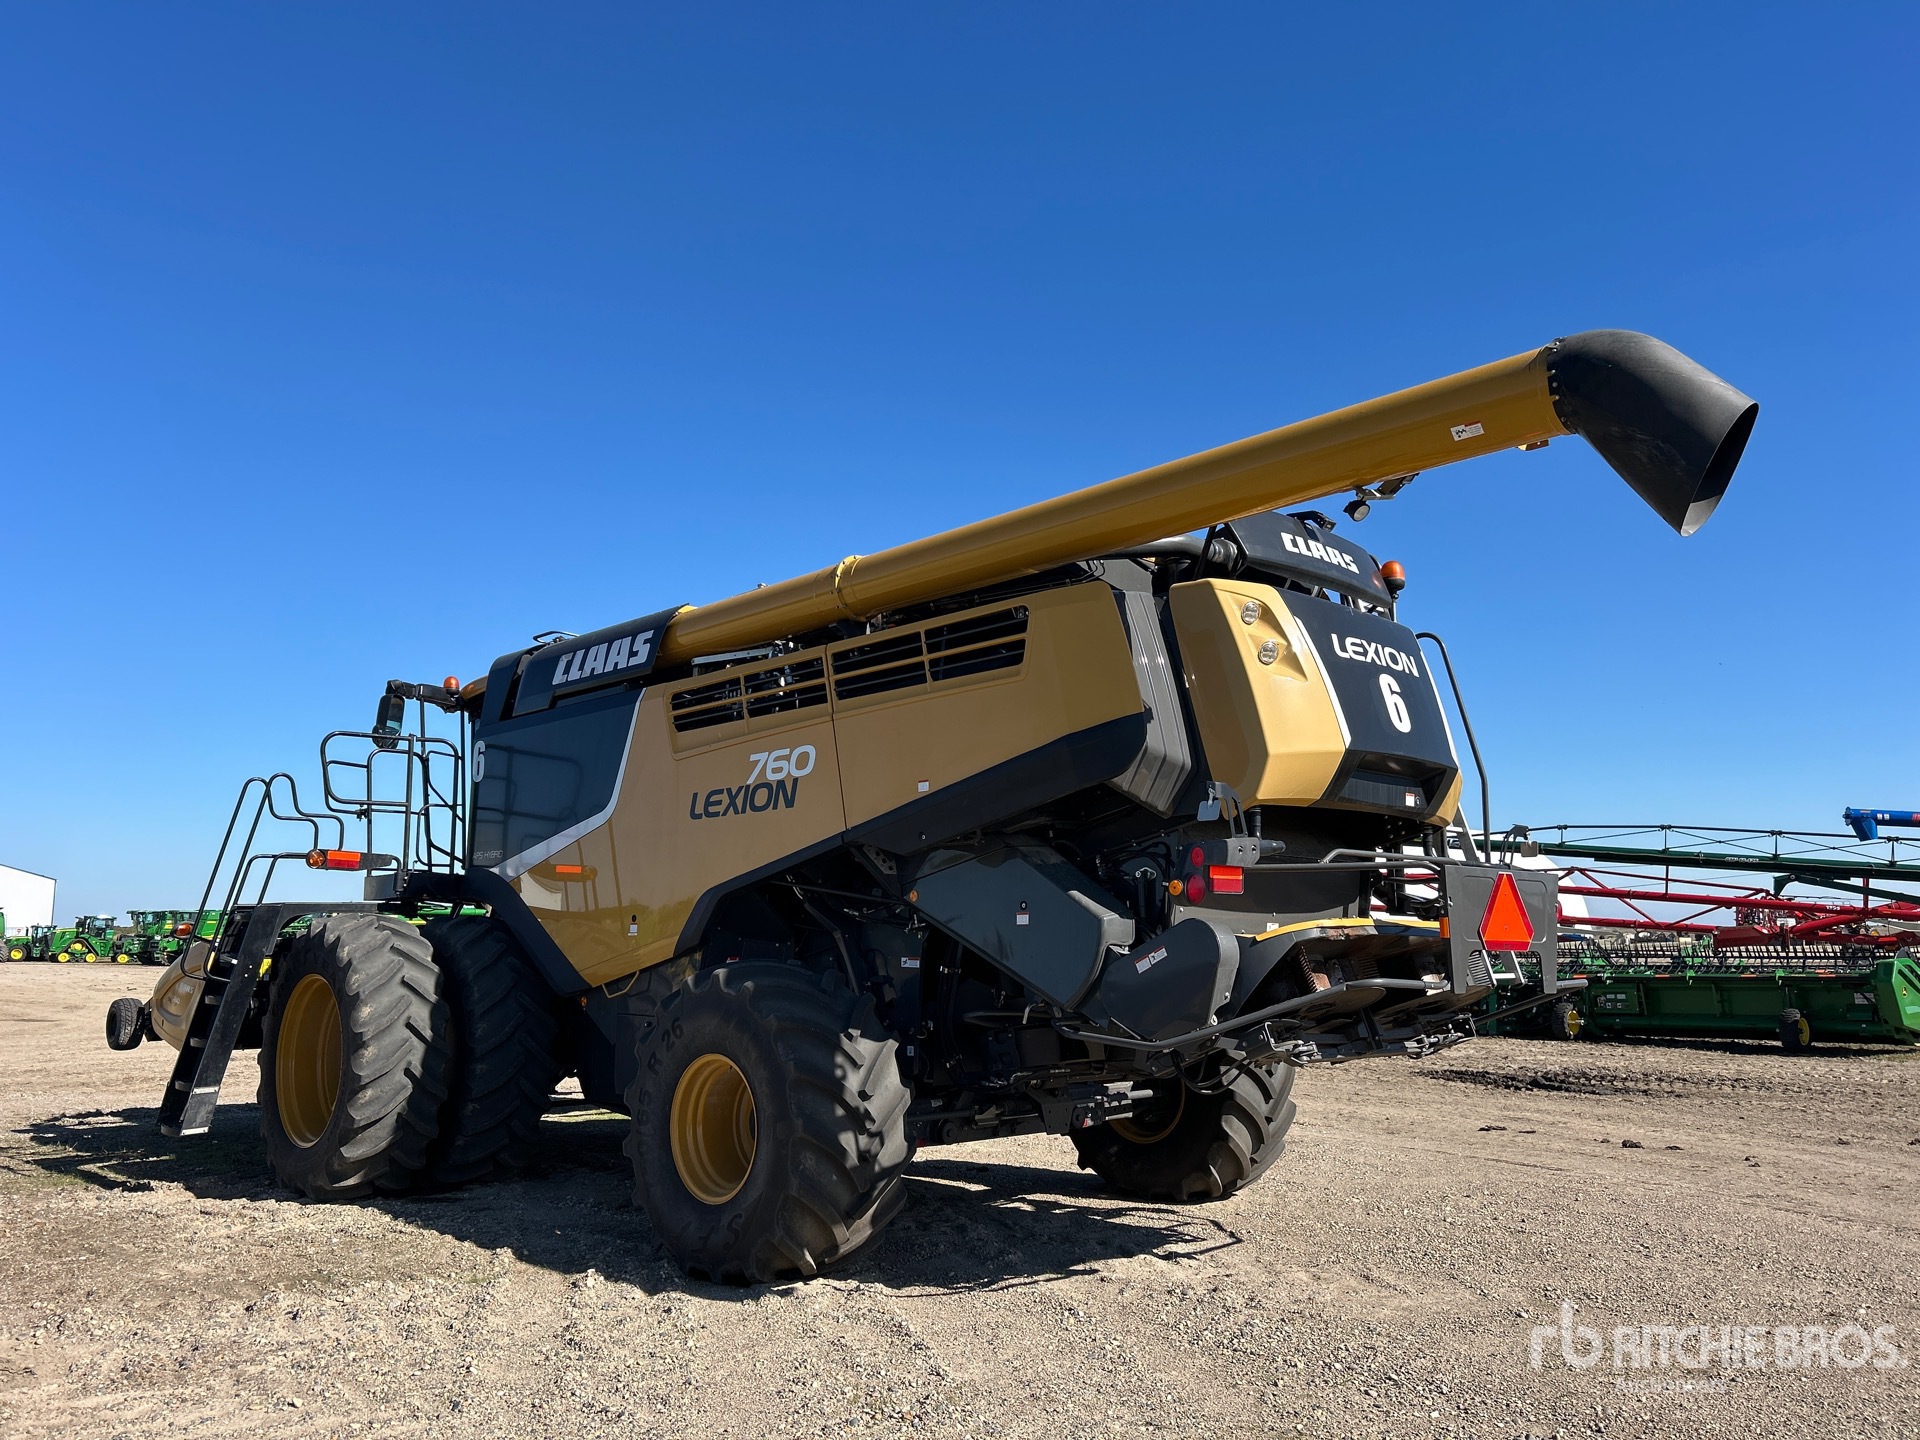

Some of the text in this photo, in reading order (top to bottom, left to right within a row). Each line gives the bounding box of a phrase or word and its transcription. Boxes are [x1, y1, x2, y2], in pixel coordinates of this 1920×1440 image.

[1281, 532, 1359, 574] CLAAS
[552, 630, 654, 685] CLAAS
[1331, 633, 1419, 678] LEXION
[1378, 673, 1412, 733] 6
[472, 740, 486, 783] 6
[746, 744, 816, 785] 760
[690, 778, 798, 820] LEXION
[661, 1016, 685, 1052] 26
